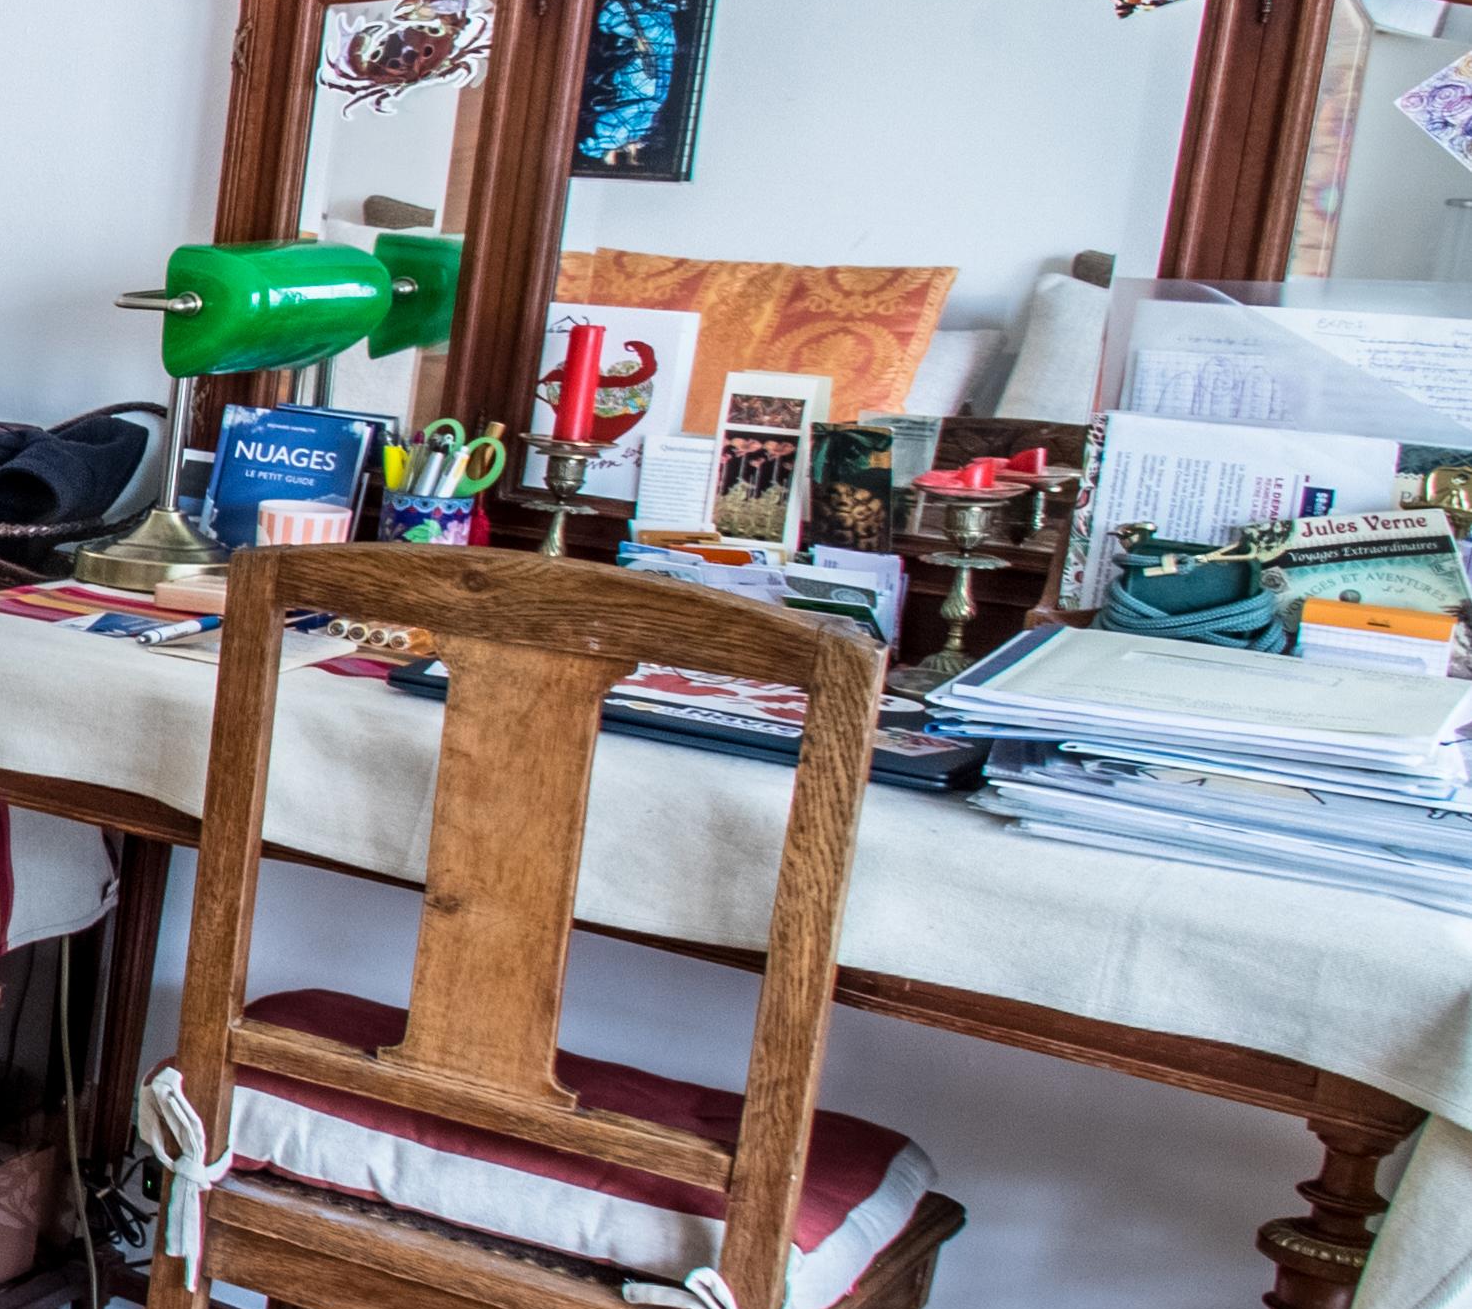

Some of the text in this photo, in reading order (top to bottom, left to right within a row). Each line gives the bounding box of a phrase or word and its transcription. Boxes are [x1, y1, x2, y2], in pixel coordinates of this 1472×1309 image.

[234, 439, 338, 471] NUAGES
[245, 469, 316, 487] LE PETIT GUIDE
[1301, 515, 1428, 538] Jules Verne
[1289, 541, 1438, 564] Voyages Extraordinaires
[1341, 573, 1359, 584] ET
[1366, 572, 1448, 602] AVENTURES
